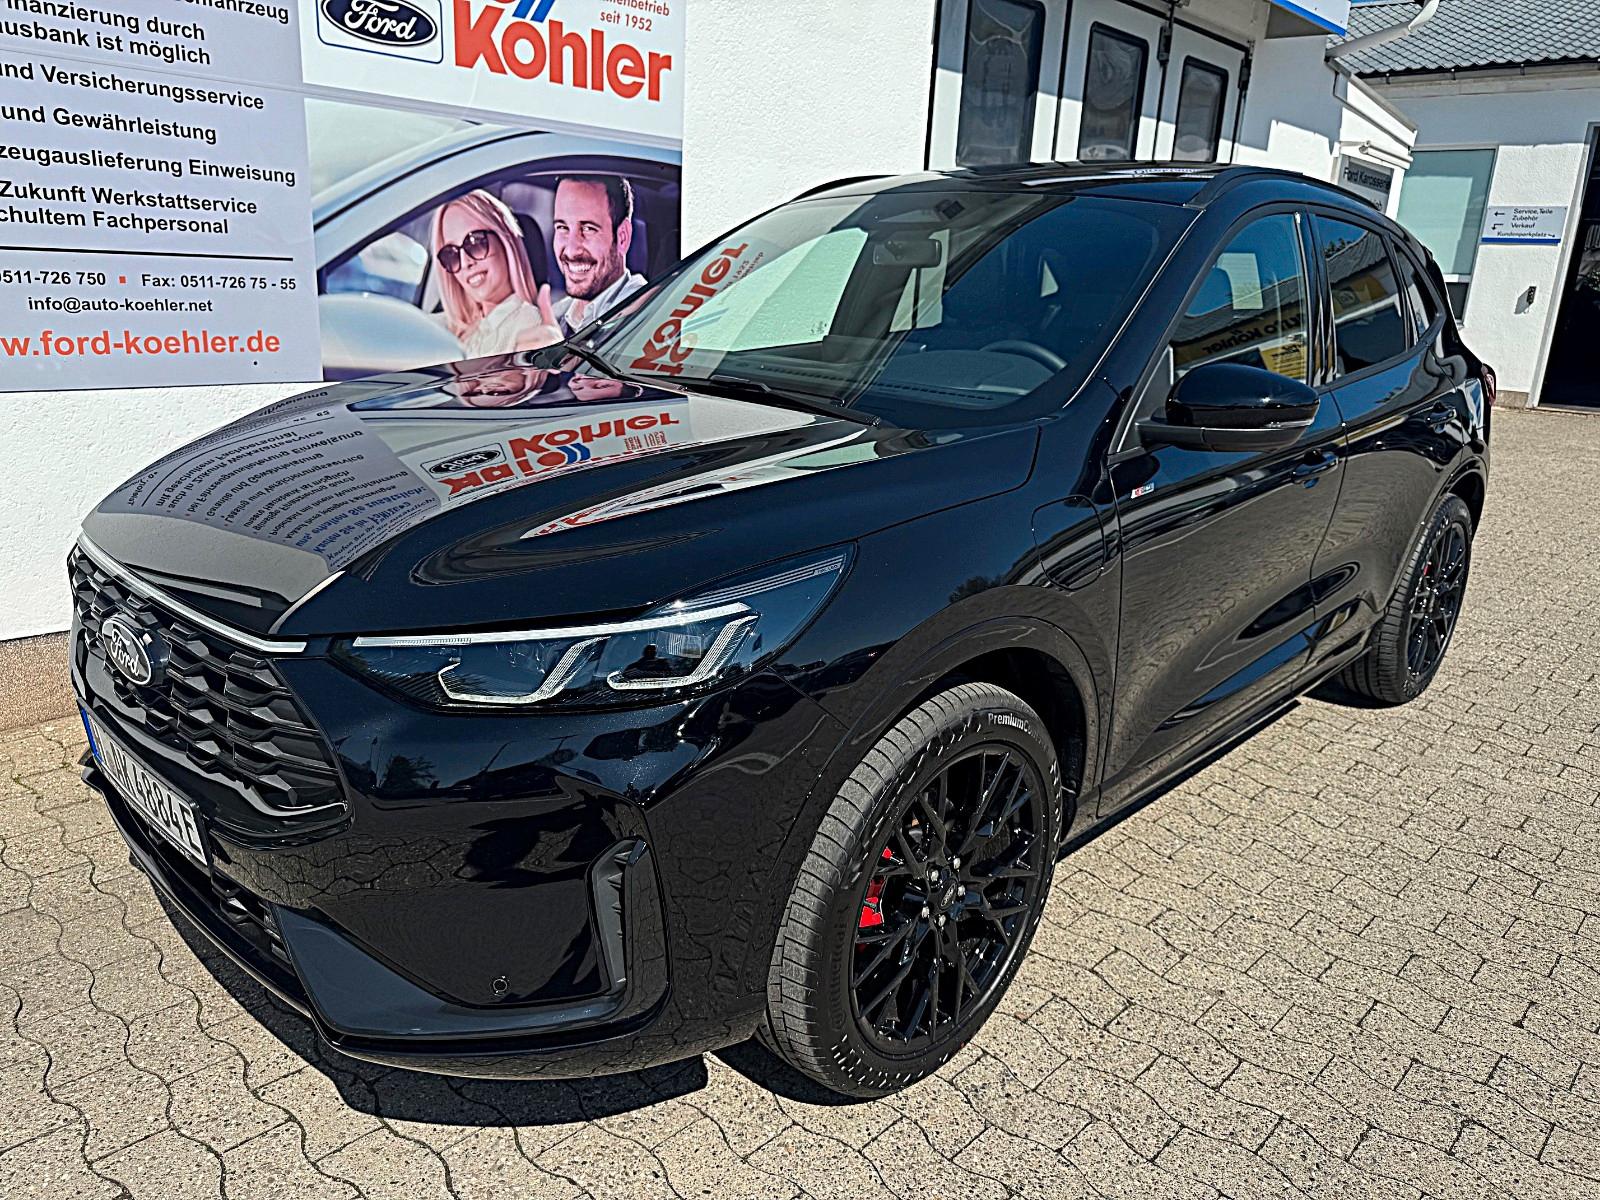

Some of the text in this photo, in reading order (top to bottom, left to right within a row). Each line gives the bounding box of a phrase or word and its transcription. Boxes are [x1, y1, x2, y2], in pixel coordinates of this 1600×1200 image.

[146, 16, 206, 41] durch
[599, 10, 653, 32] seit 1952
[0, 20, 211, 65] usbank ist möglich
[452, 0, 672, 102] Köhler
[0, 62, 265, 110] nd Versicherungsservice
[1, 104, 217, 145] und Gewährleistung
[189, 159, 296, 187] Einweisung
[0, 180, 258, 214] Zukunft Werkstattservice
[1513, 207, 1539, 215] Service,
[93, 209, 229, 235] Fachpersonal
[0, 270, 106, 286] 511-726 750
[141, 274, 176, 288] Fax:
[180, 275, 247, 290] 0511-726
[250, 276, 267, 290] 75
[280, 277, 297, 290] 55
[28, 296, 214, 314] info@auto-koehler.net
[111, 627, 140, 677] Ford
[131, 763, 203, 854] 4884E
